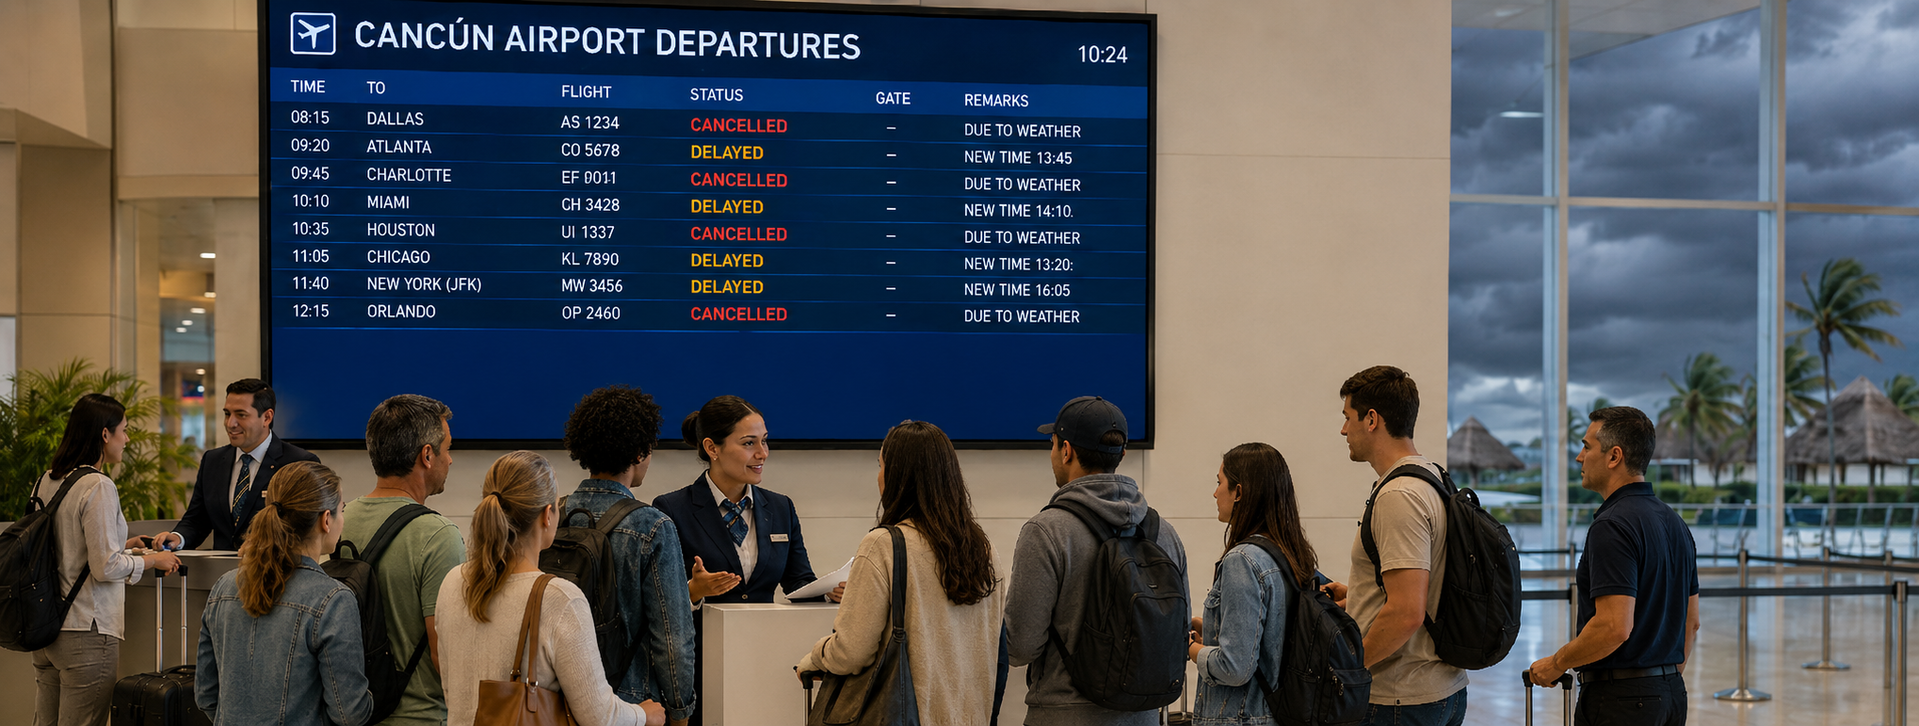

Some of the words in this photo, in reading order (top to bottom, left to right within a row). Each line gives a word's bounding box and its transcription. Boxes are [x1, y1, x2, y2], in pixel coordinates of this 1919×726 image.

[355, 16, 494, 51] CANCÚN
[504, 25, 646, 55] AIRPORT
[656, 28, 861, 60] DEPARTURES
[1078, 44, 1128, 64] 10:24
[290, 79, 326, 94] TIME
[366, 80, 386, 95] TO
[561, 84, 613, 99] FLIGHT
[690, 87, 744, 102] STATUS
[875, 91, 911, 105] GATE
[964, 93, 1029, 108] REMARKS
[291, 109, 330, 125] 08:15
[367, 111, 424, 126] DALLAS
[560, 114, 581, 129] AS
[585, 115, 620, 130] 1234
[690, 117, 788, 134] CANCELLED
[964, 122, 992, 137] DUE
[995, 122, 1013, 137] TO
[1016, 123, 1081, 138] WEATHER
[291, 137, 330, 153] 09:20
[366, 139, 433, 154] ATLANTA
[561, 142, 581, 157] CO
[584, 142, 620, 158] 5678
[690, 144, 764, 160] DELAYED
[964, 150, 996, 165] NEW
[999, 150, 1032, 165] TIME
[1037, 151, 1073, 165] 13:45
[291, 165, 330, 181] 09:45
[366, 167, 452, 183] CHARLOTTE
[561, 170, 580, 184] EF
[690, 171, 788, 188] CANCELLED
[964, 176, 992, 191] DUE
[995, 176, 1013, 191] TO
[1016, 177, 1081, 192] WEATHER
[292, 193, 330, 208] 10:10
[367, 195, 410, 209] MIAMI
[585, 197, 620, 212] 3428
[690, 198, 764, 214] DELAYED
[964, 203, 996, 218] NEW
[999, 203, 1032, 218] TIME
[292, 221, 330, 236] 10:35
[367, 222, 435, 237] HOUSTON
[561, 225, 575, 239] UI
[581, 225, 615, 239] 1337
[690, 226, 788, 242] CANCELLED
[964, 230, 992, 244] DUE
[995, 230, 1013, 244] TO
[1016, 230, 1081, 245] WEATHER
[292, 248, 330, 263] 11:05
[367, 249, 431, 264] CHICAGO
[561, 251, 581, 266] KL
[584, 252, 620, 266] 7890
[690, 252, 764, 268] DELAYED
[964, 257, 996, 271] NEW
[999, 257, 1032, 271] TIME
[292, 276, 330, 291] 11:40
[367, 276, 400, 291] NEW
[403, 276, 442, 291] YORK
[445, 277, 482, 293] (JFK)
[561, 278, 586, 293] MW
[589, 278, 623, 293] 3456
[690, 279, 764, 294] DELAYED
[964, 282, 996, 297] NEW
[999, 282, 1032, 297] TIME
[1035, 283, 1071, 297] 16:05
[292, 303, 330, 318] 12:15
[367, 304, 436, 319] ORLANDO
[562, 305, 582, 320] OP
[586, 305, 621, 320] 2460
[690, 306, 788, 322] CANCELLED
[964, 309, 992, 323] DUE
[995, 309, 1013, 323] TO
[1016, 309, 1080, 324] WEATHER
